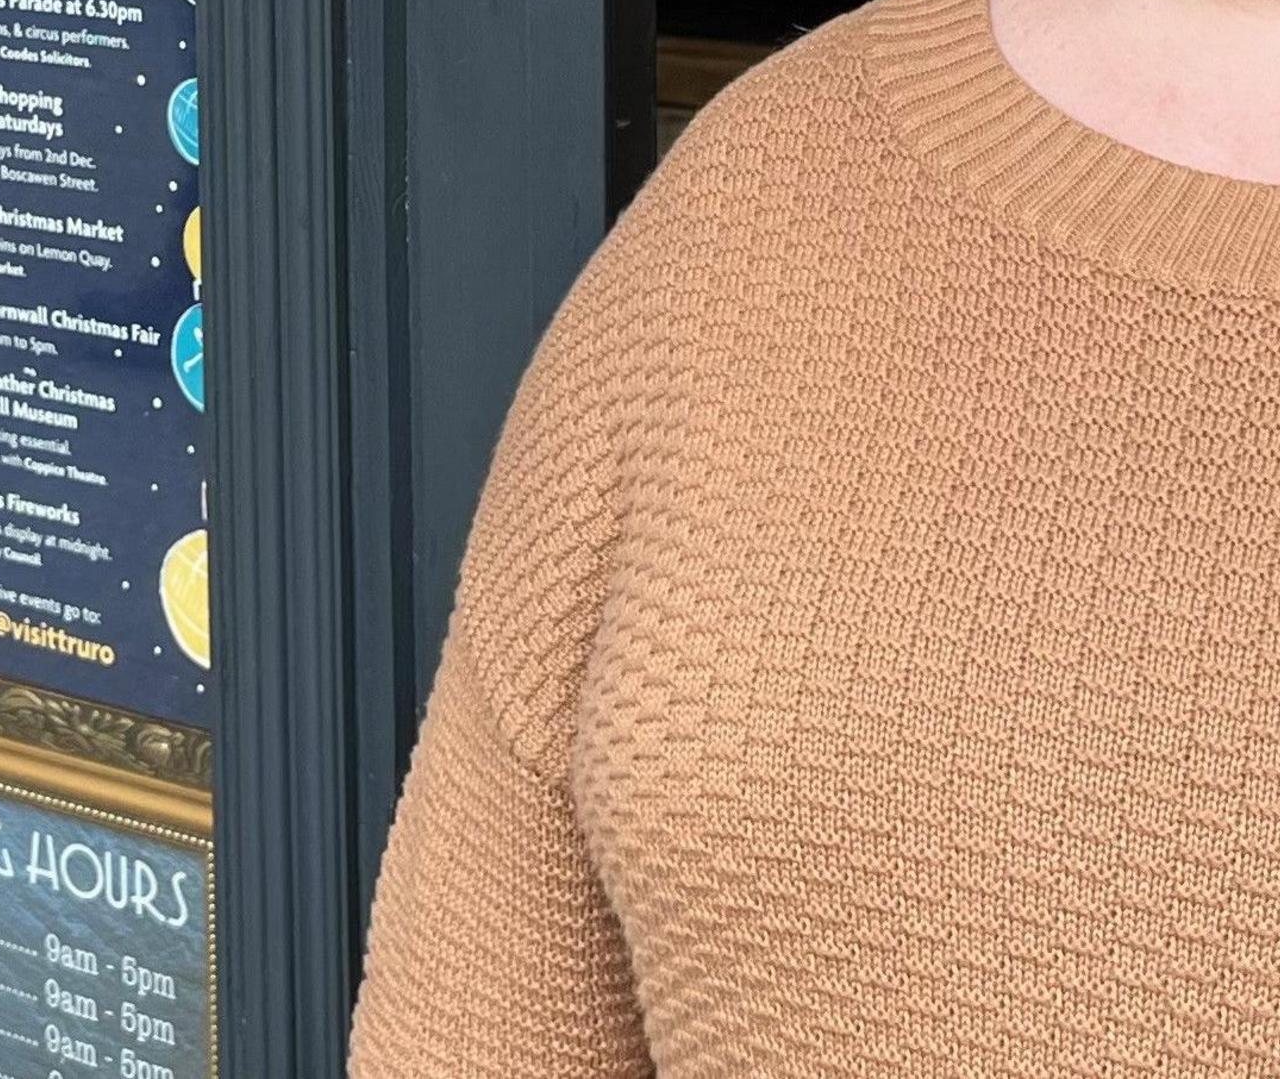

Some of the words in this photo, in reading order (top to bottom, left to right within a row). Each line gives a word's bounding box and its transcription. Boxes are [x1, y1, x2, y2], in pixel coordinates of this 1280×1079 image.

[11, 21, 24, 38] &
[24, 23, 60, 42] circus
[12, 142, 43, 162] from
[43, 147, 68, 166] 2nd
[65, 215, 125, 243] Market
[49, 309, 129, 341] Christmas
[130, 322, 161, 346] Fair
[37, 379, 116, 412] Christmas
[11, 399, 78, 430] Museum
[5, 492, 81, 526] Fireworks
[17, 592, 62, 615] events
[61, 603, 81, 623] go
[25, 830, 189, 927] HOURS
[43, 931, 100, 976] 9am
[120, 954, 177, 1001] 5pm
[43, 977, 99, 1022] 9am
[120, 1000, 176, 1046] 5pm
[44, 1024, 99, 1068] 9am
